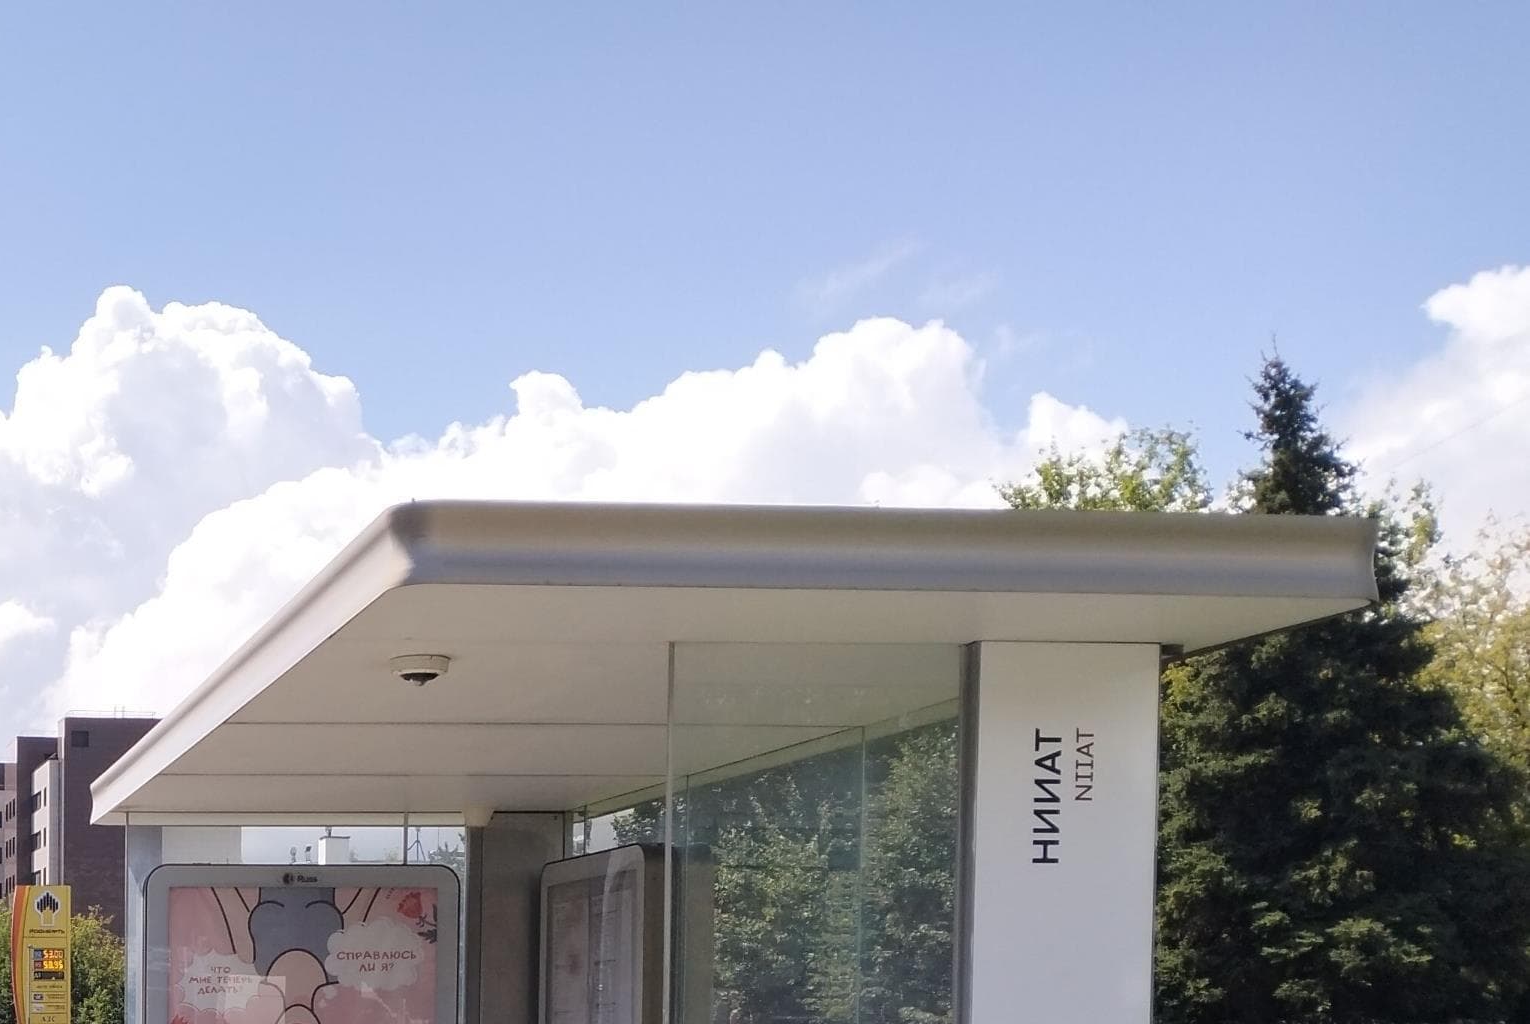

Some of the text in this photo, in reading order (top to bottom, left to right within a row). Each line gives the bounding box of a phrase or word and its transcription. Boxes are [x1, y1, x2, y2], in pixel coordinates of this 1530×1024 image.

[1074, 727, 1095, 801] NIIAT
[1032, 727, 1062, 864] НИИАТ
[336, 950, 417, 960] СПРАВЛЮСЬ
[210, 966, 231, 974] ЧТО
[359, 962, 376, 972] ЛИ
[188, 976, 212, 984] МНЕ
